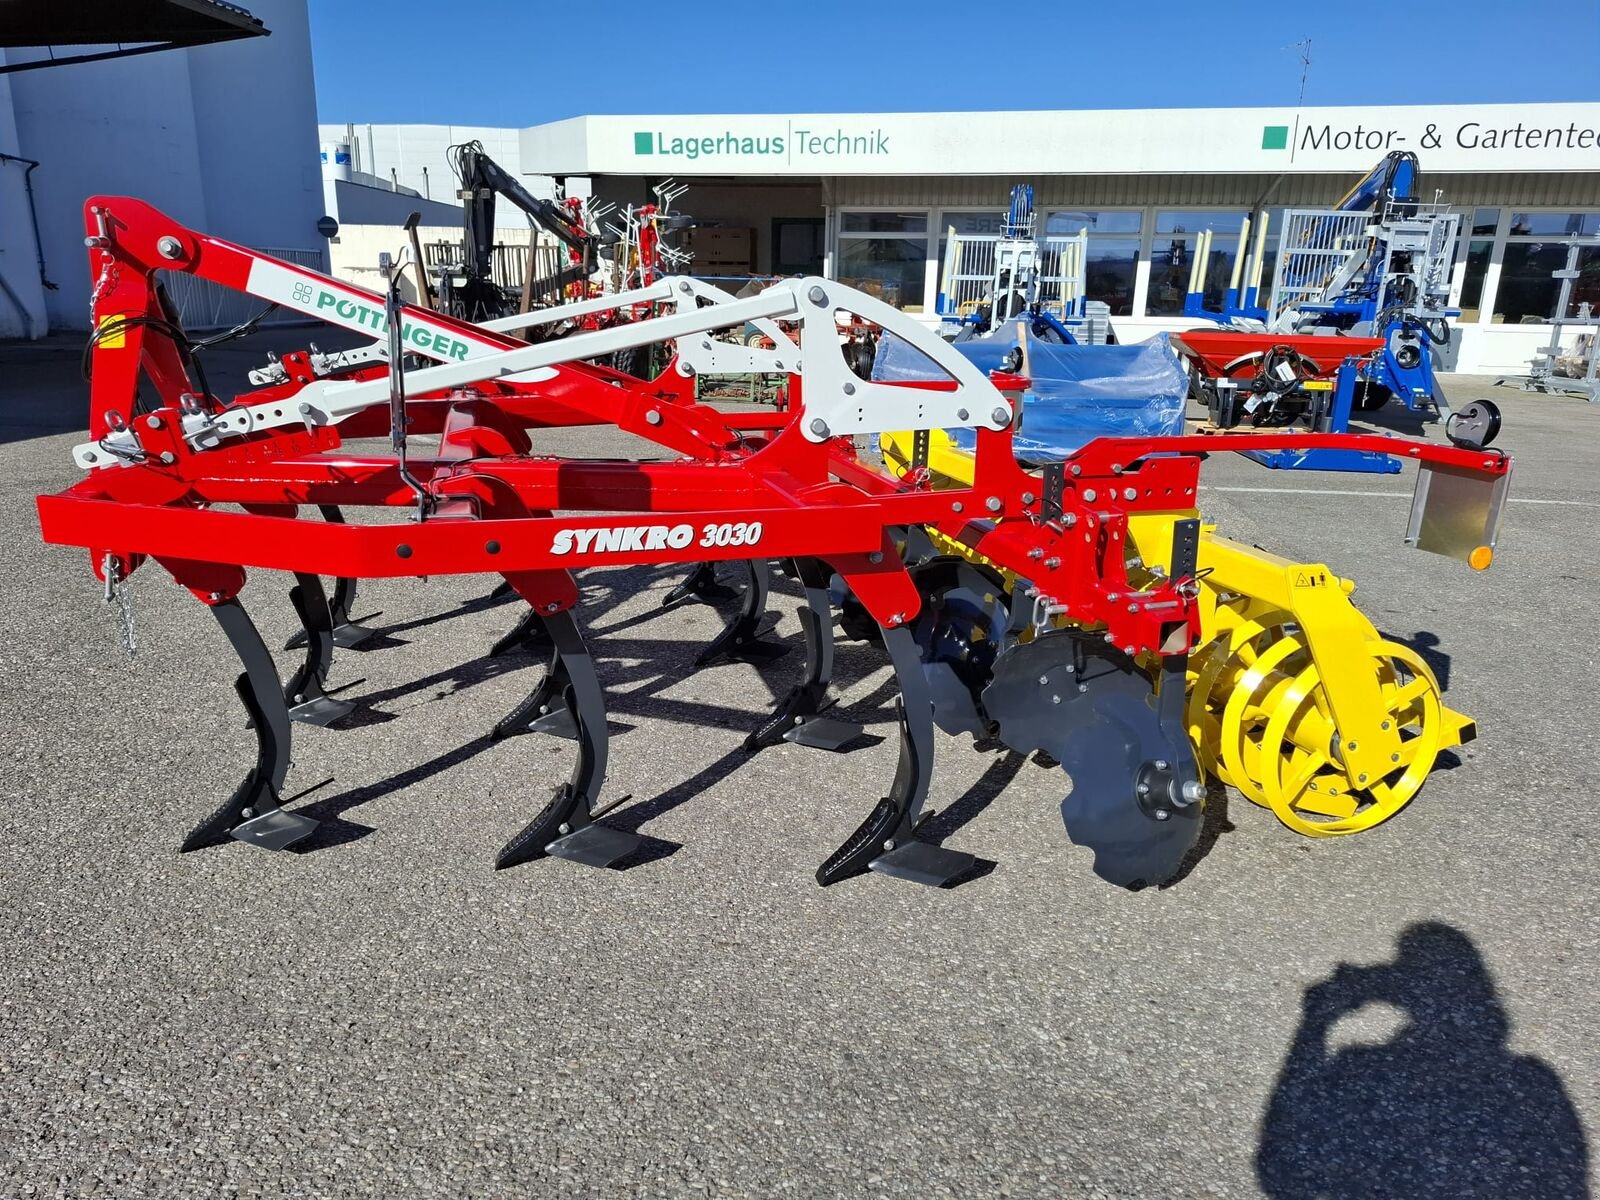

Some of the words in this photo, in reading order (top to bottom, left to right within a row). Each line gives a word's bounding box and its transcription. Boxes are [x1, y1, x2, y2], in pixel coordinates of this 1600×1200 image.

[658, 131, 785, 160] Lagerhaus
[795, 128, 890, 155] Technik
[1300, 124, 1406, 151] Motor-
[1419, 123, 1442, 149] &
[1456, 122, 1600, 149] Gartente
[549, 524, 695, 555] SYNKRO
[700, 521, 764, 548] 3030
